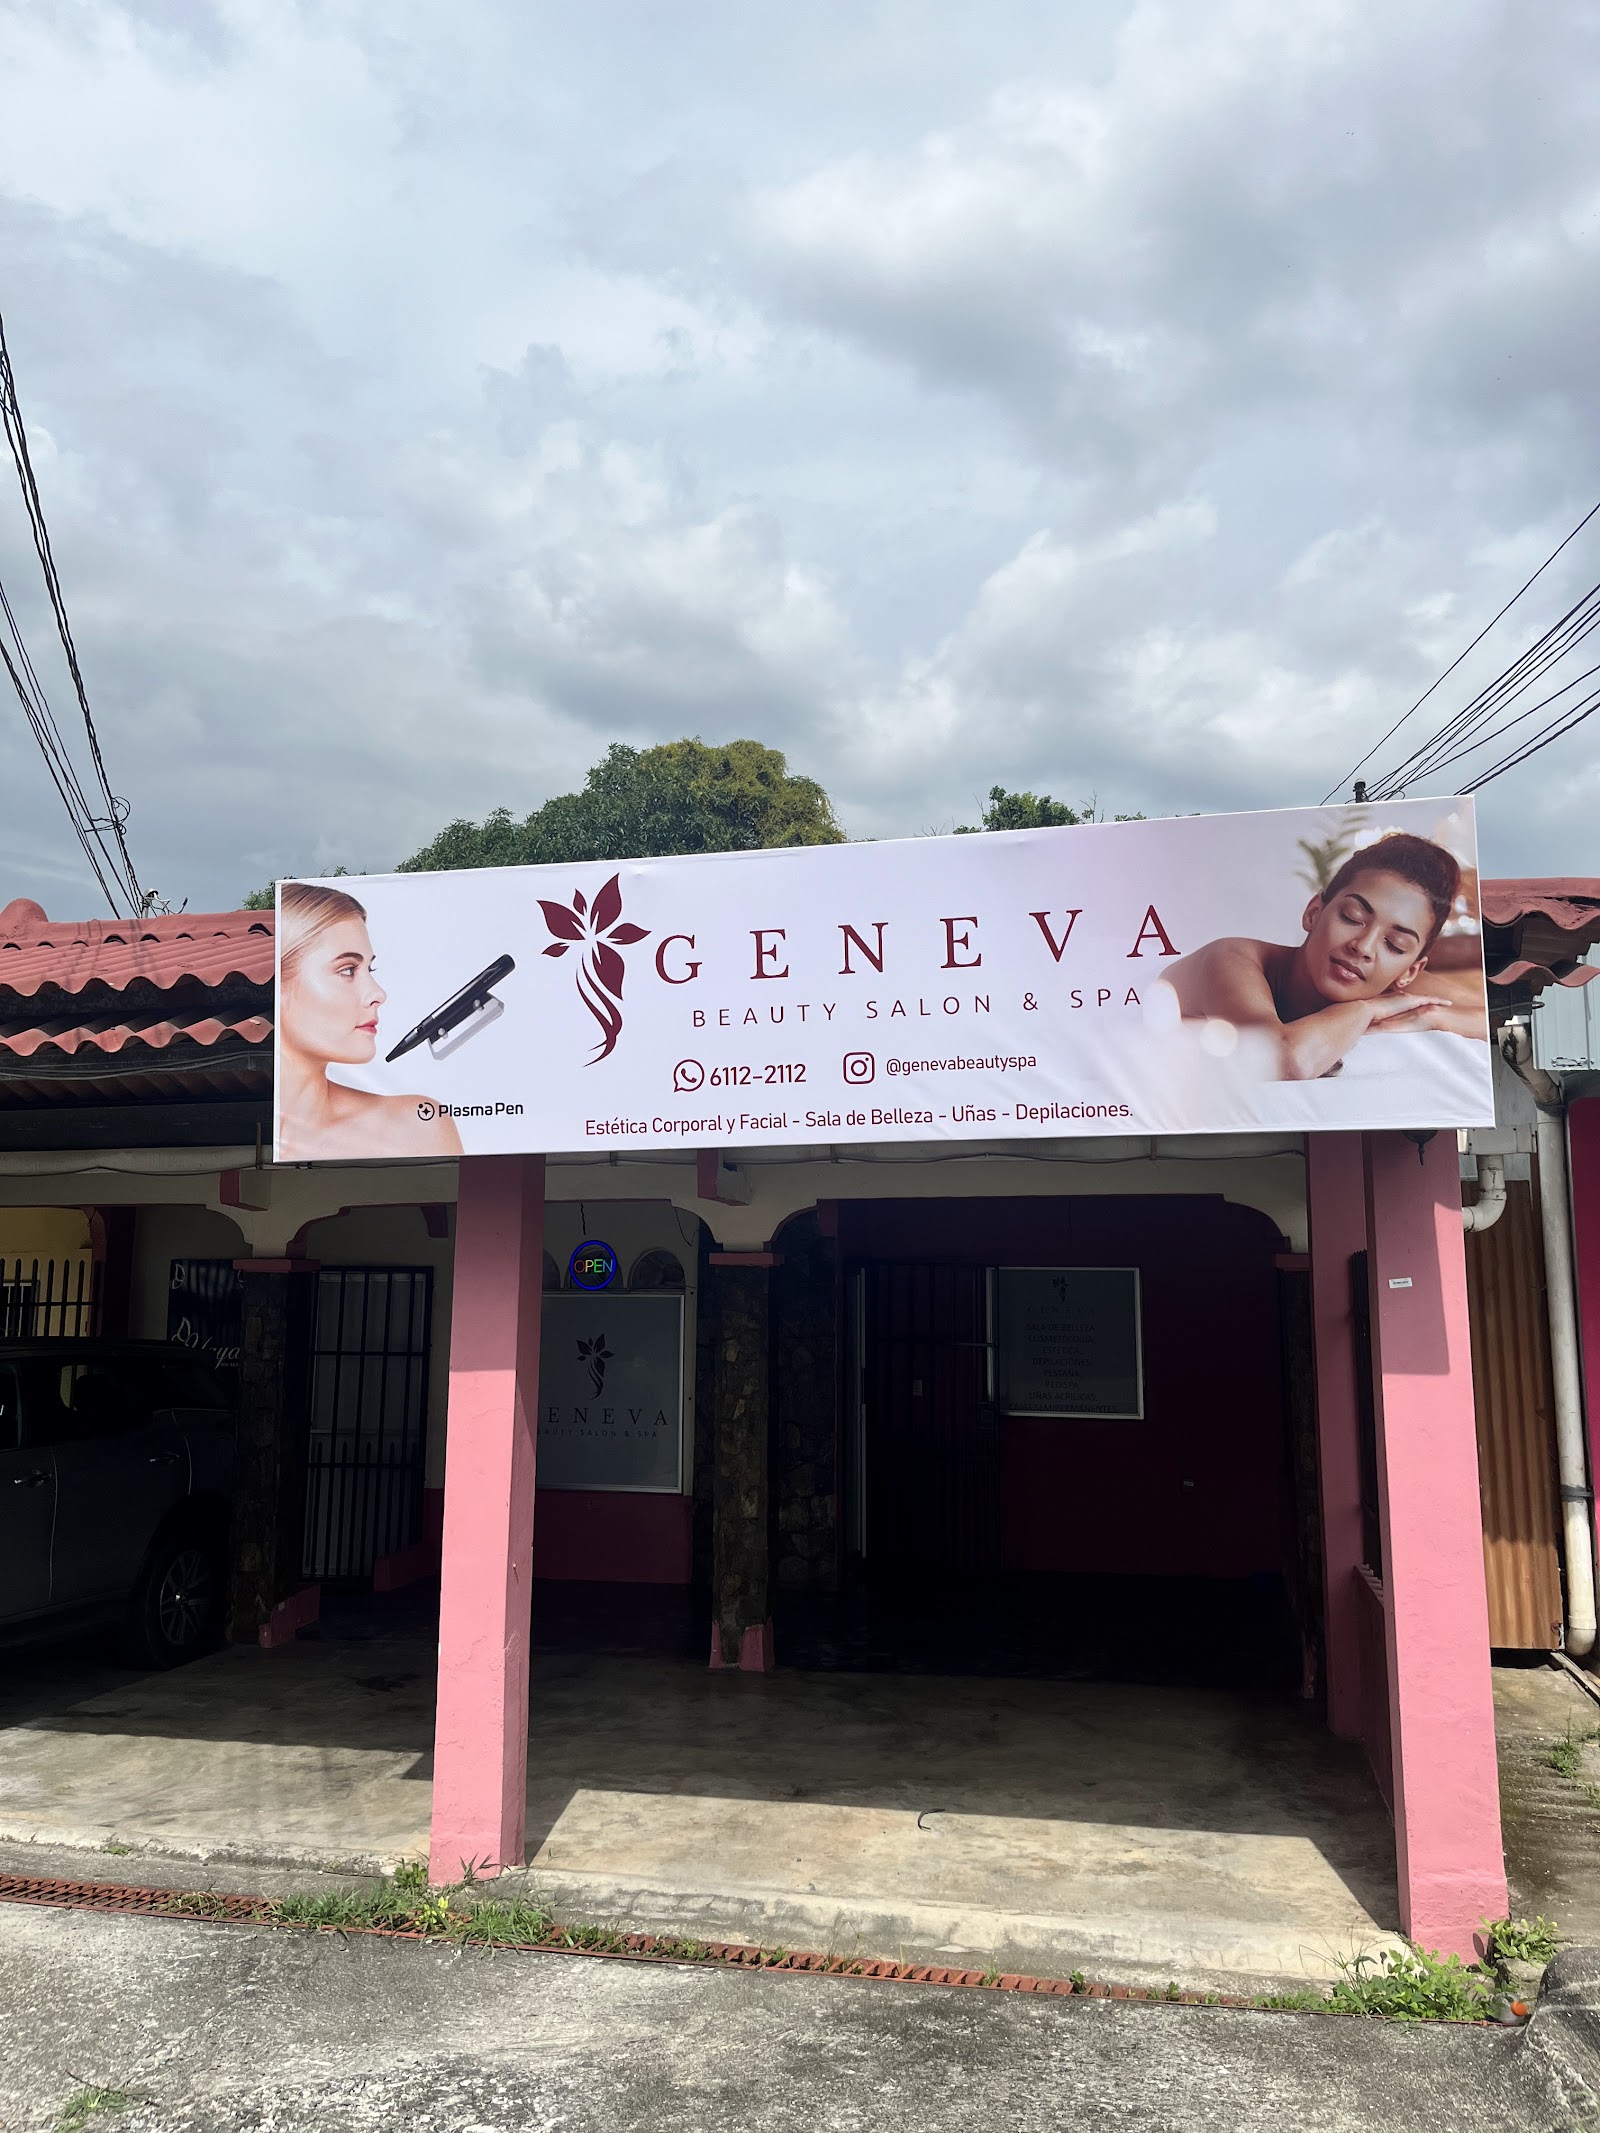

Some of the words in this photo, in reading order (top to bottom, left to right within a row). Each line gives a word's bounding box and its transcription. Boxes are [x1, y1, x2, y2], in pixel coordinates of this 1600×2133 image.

[656, 904, 1181, 984] GENEVA
[693, 1002, 836, 1028] BEAUTY
[866, 994, 990, 1018] SALON
[1022, 992, 1039, 1011] &
[1070, 987, 1141, 1009] SPA
[709, 1063, 807, 1087] 6112-2112
[886, 1054, 1037, 1076] @genevabeautyspa
[585, 1116, 648, 1136] Estética
[652, 1114, 723, 1137] Corporal
[726, 1118, 736, 1135] y
[740, 1112, 788, 1130] Facial
[805, 1110, 841, 1128] Sala
[846, 1109, 866, 1126] de
[871, 1107, 933, 1125] Belleza
[952, 1104, 997, 1122] Uñas
[1015, 1102, 1134, 1124] Depilaciones.
[574, 1259, 613, 1273] OPEN
[1026, 1323, 1046, 1332] SALA
[1049, 1323, 1058, 1332] DE
[1061, 1323, 1096, 1333] BELLEZA
[547, 1407, 669, 1425] ENEVA
[538, 1429, 572, 1437] EAUTY
[580, 1429, 616, 1438] SALON
[637, 1431, 657, 1439] SPA
